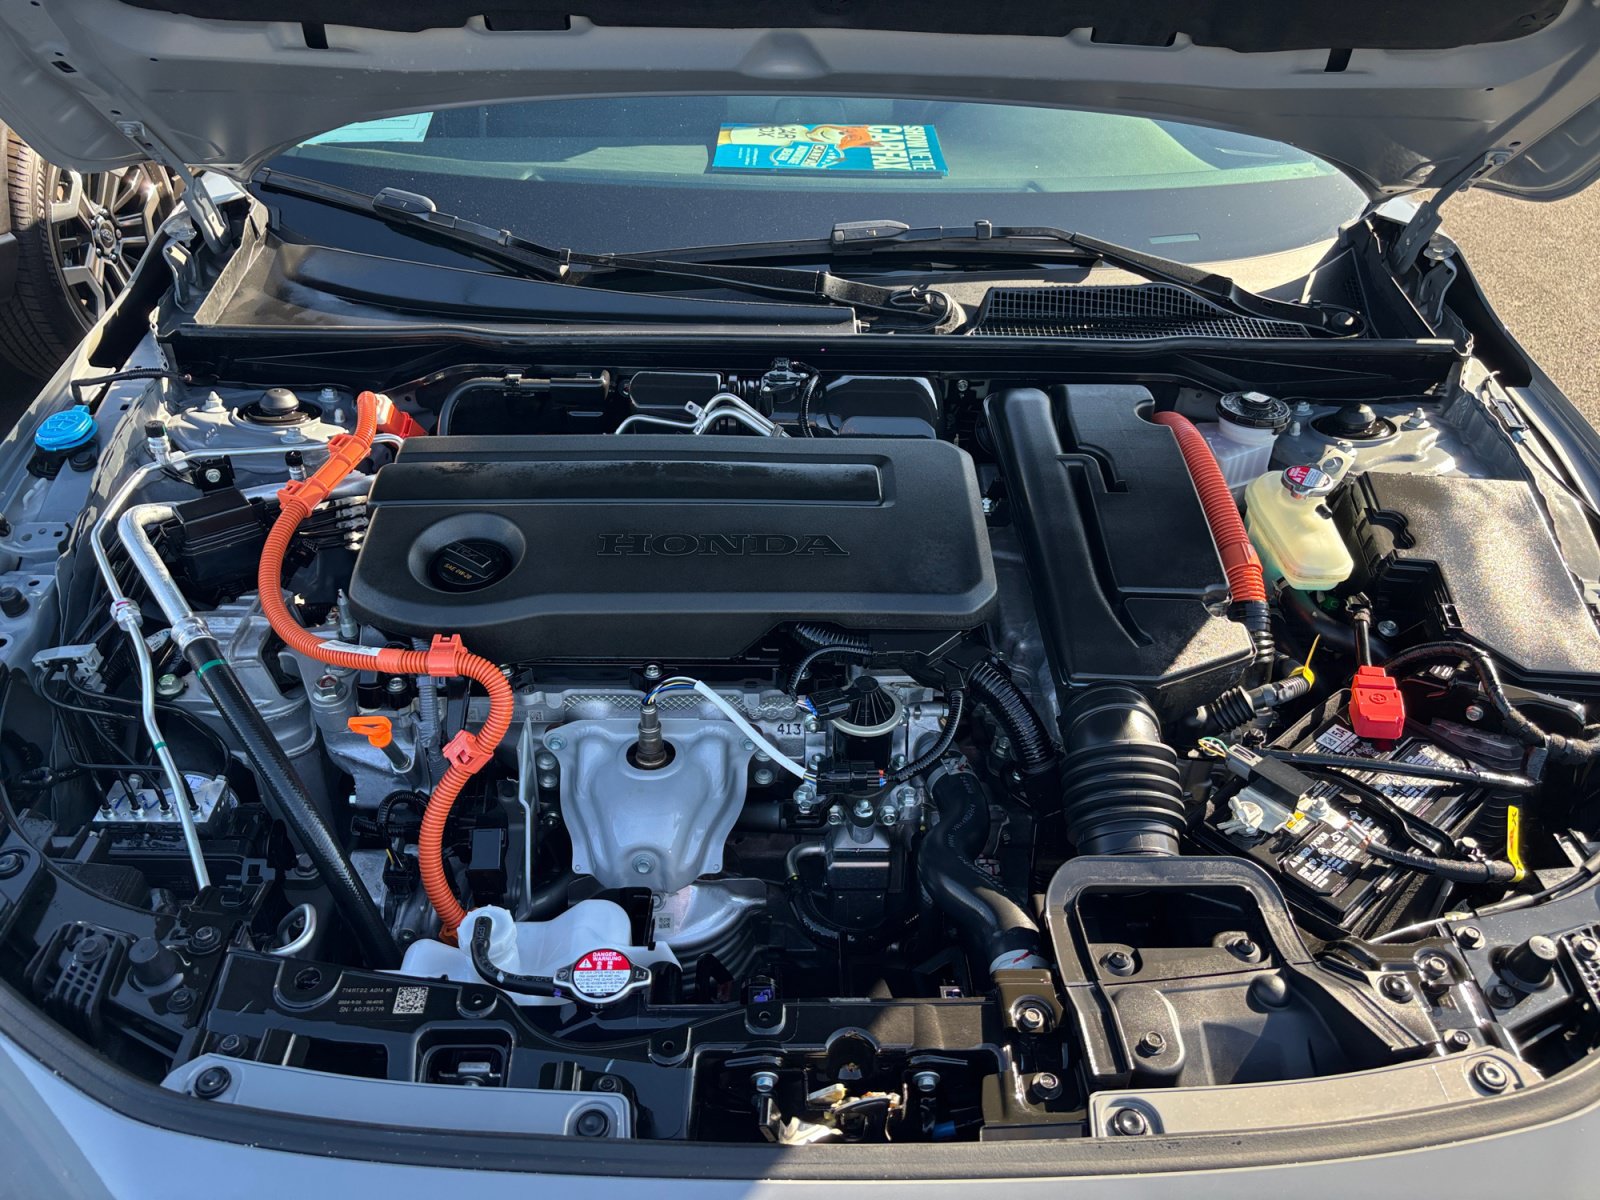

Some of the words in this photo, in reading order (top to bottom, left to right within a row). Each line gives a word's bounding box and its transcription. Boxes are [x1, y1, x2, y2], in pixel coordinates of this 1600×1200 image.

[902, 125, 929, 147] SHOW
[867, 125, 910, 170] CARFAX
[596, 533, 850, 556] HONDA
[777, 723, 801, 735] 413
[1331, 727, 1348, 739] 5A
